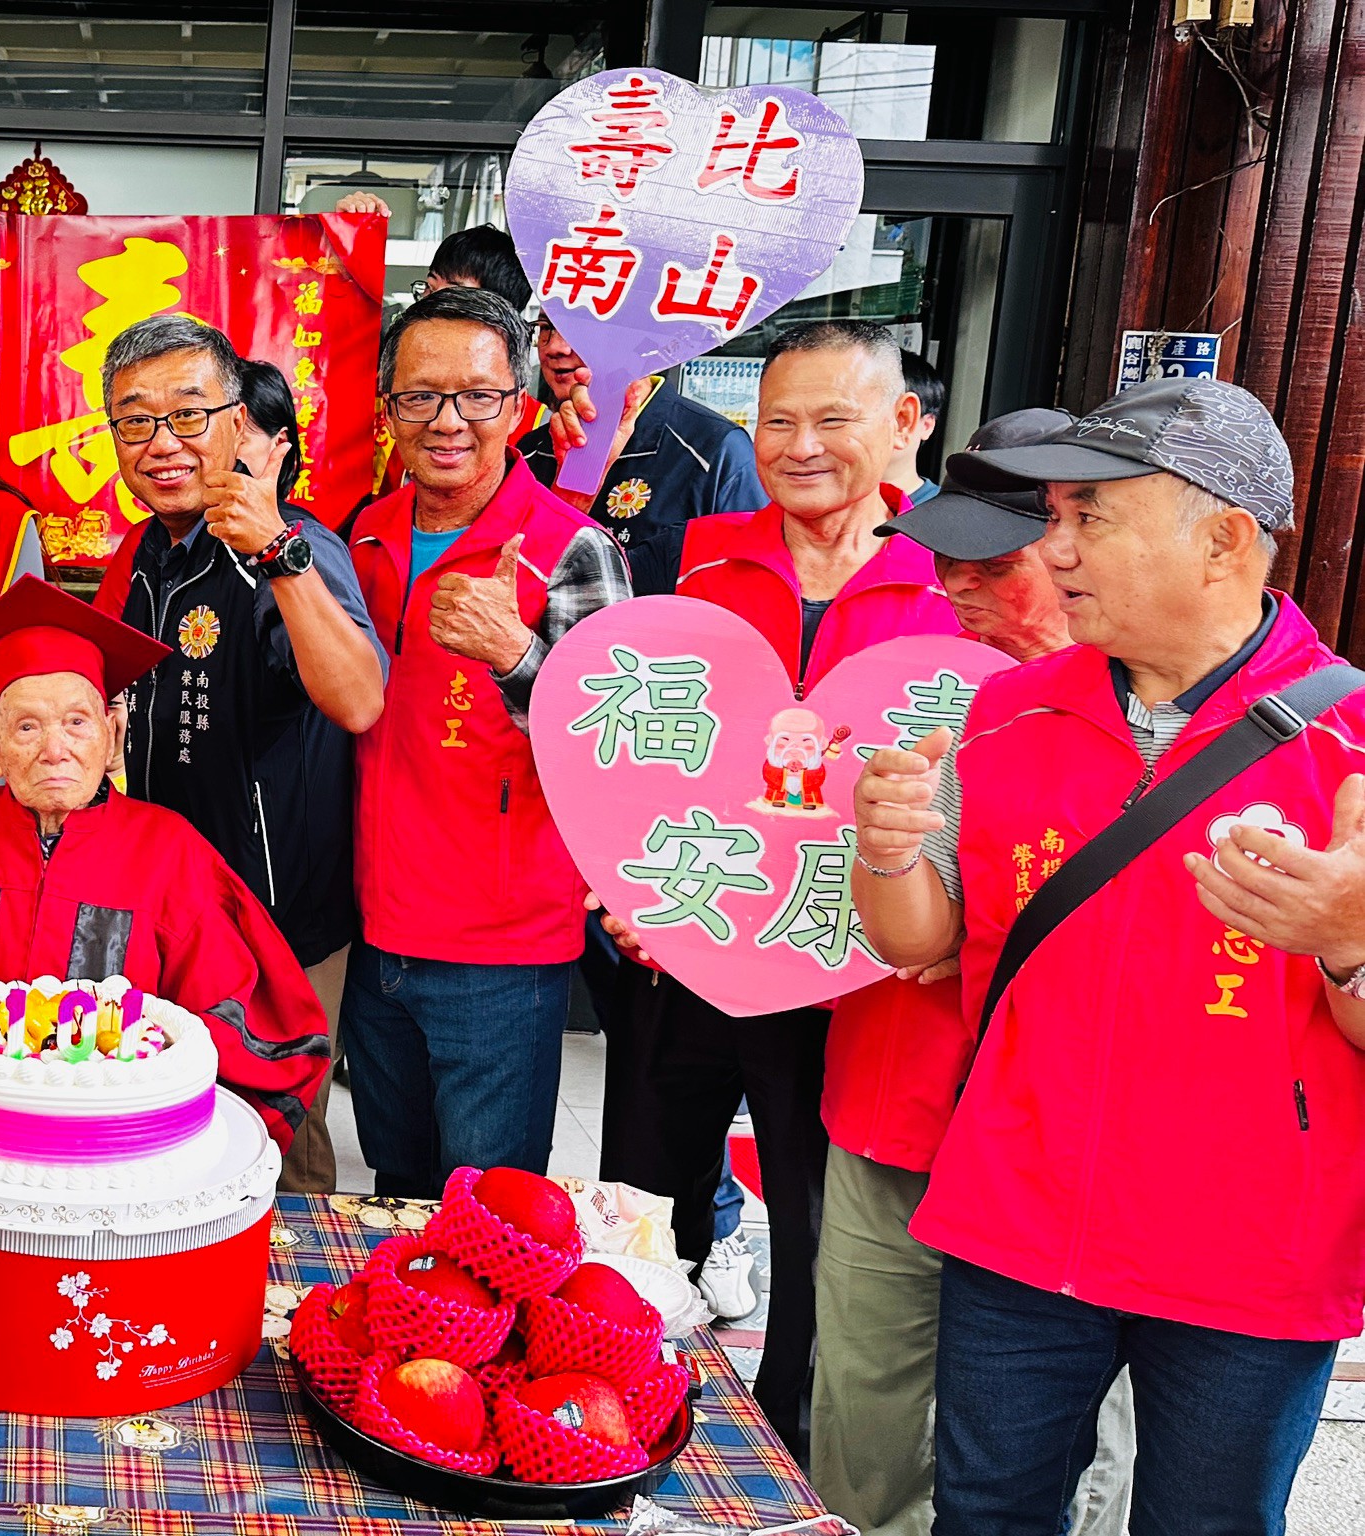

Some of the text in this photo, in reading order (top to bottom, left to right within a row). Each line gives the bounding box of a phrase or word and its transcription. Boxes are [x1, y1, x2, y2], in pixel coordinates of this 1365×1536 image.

[569, 77, 803, 200] 壽比
[541, 205, 757, 331] 南山
[1122, 336, 1142, 379] 鹿谷鄉
[178, 670, 193, 764] 榮民服務處
[195, 671, 210, 731] 南投縣
[441, 670, 474, 748] 志工
[6, 988, 144, 1064] 101
[139, 1351, 216, 1378] Happy Birthday
